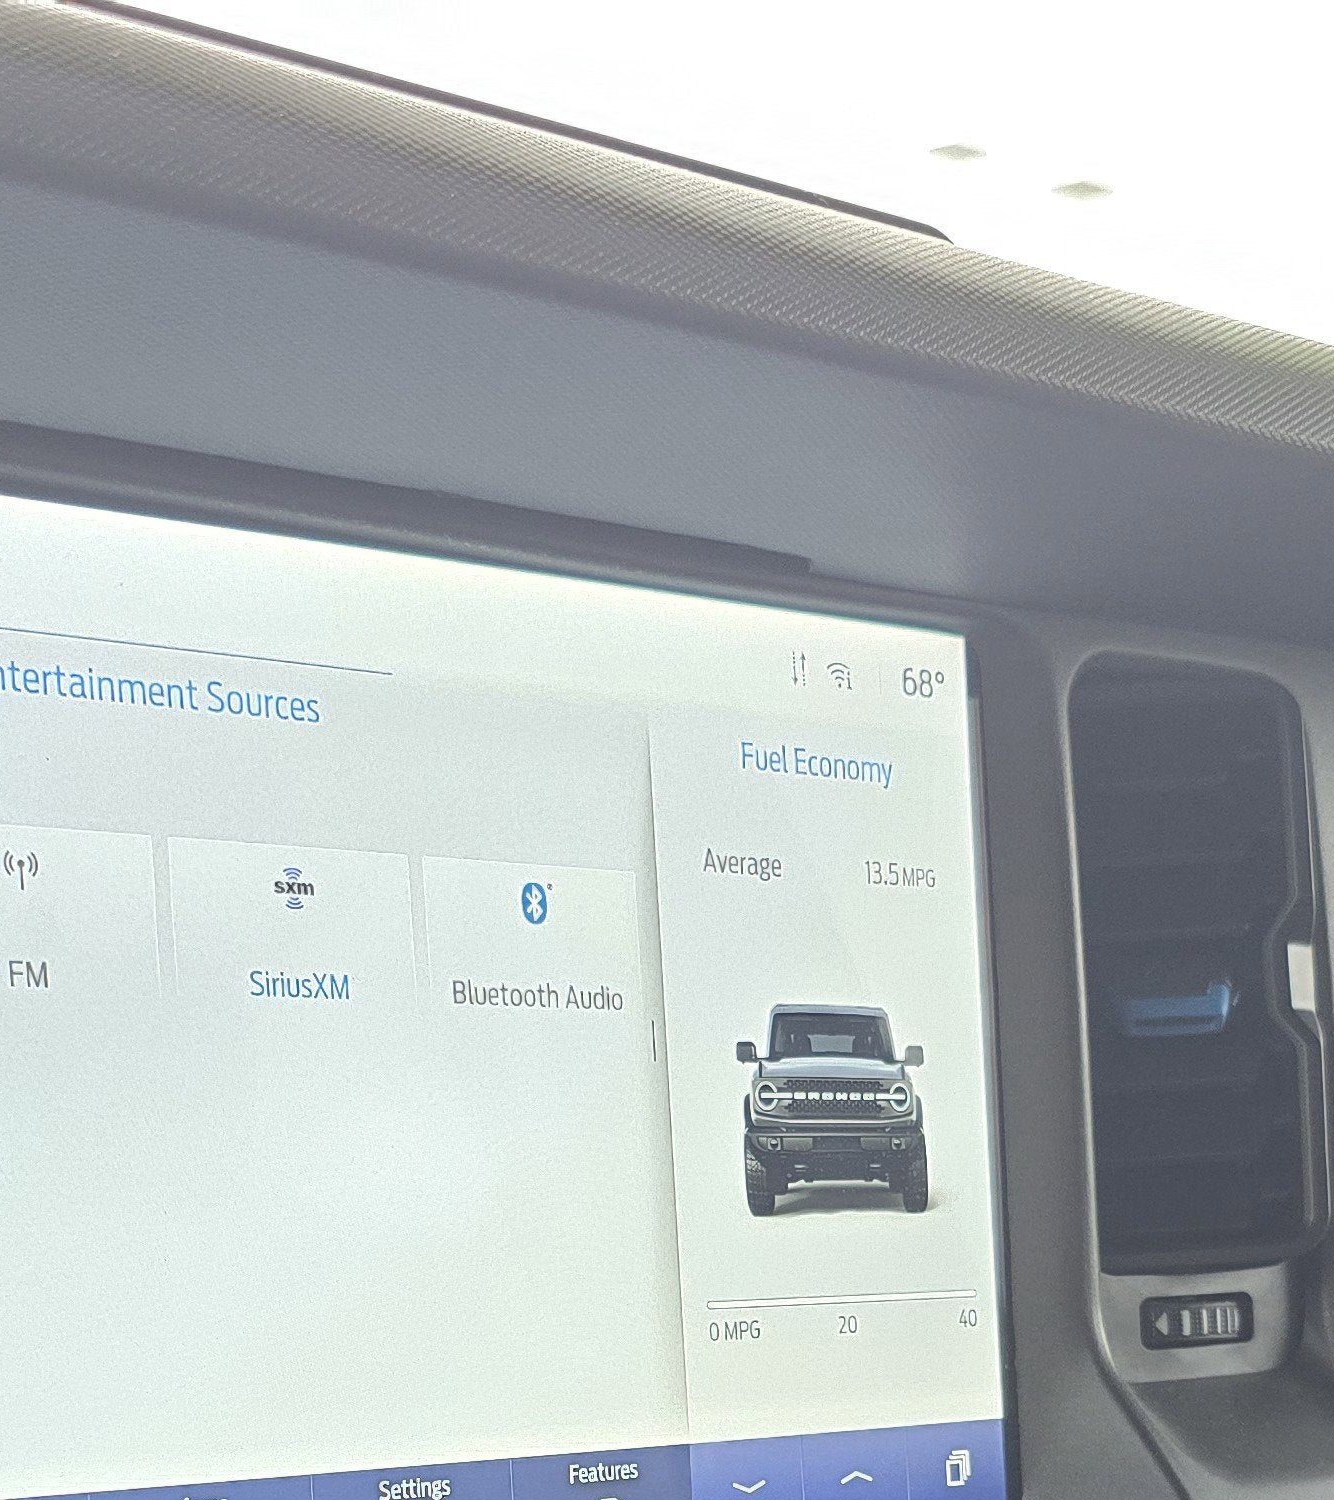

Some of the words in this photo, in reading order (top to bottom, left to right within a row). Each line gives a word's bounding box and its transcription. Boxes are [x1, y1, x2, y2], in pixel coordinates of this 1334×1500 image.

[902, 667, 945, 698] 68°
[207, 680, 321, 724] Sources
[741, 741, 788, 773] Fuel
[793, 746, 893, 789] Economy
[703, 847, 782, 881] Average
[273, 878, 315, 897] sxm
[7, 959, 50, 989] FM
[248, 969, 351, 1001] SiriusXM
[452, 978, 559, 1009] Bluetooth
[565, 984, 624, 1012] Audio
[708, 1321, 721, 1342] 0
[724, 1319, 762, 1340] MPG
[838, 1315, 858, 1335] 20
[958, 1308, 978, 1328] 40
[568, 1458, 639, 1485] Features
